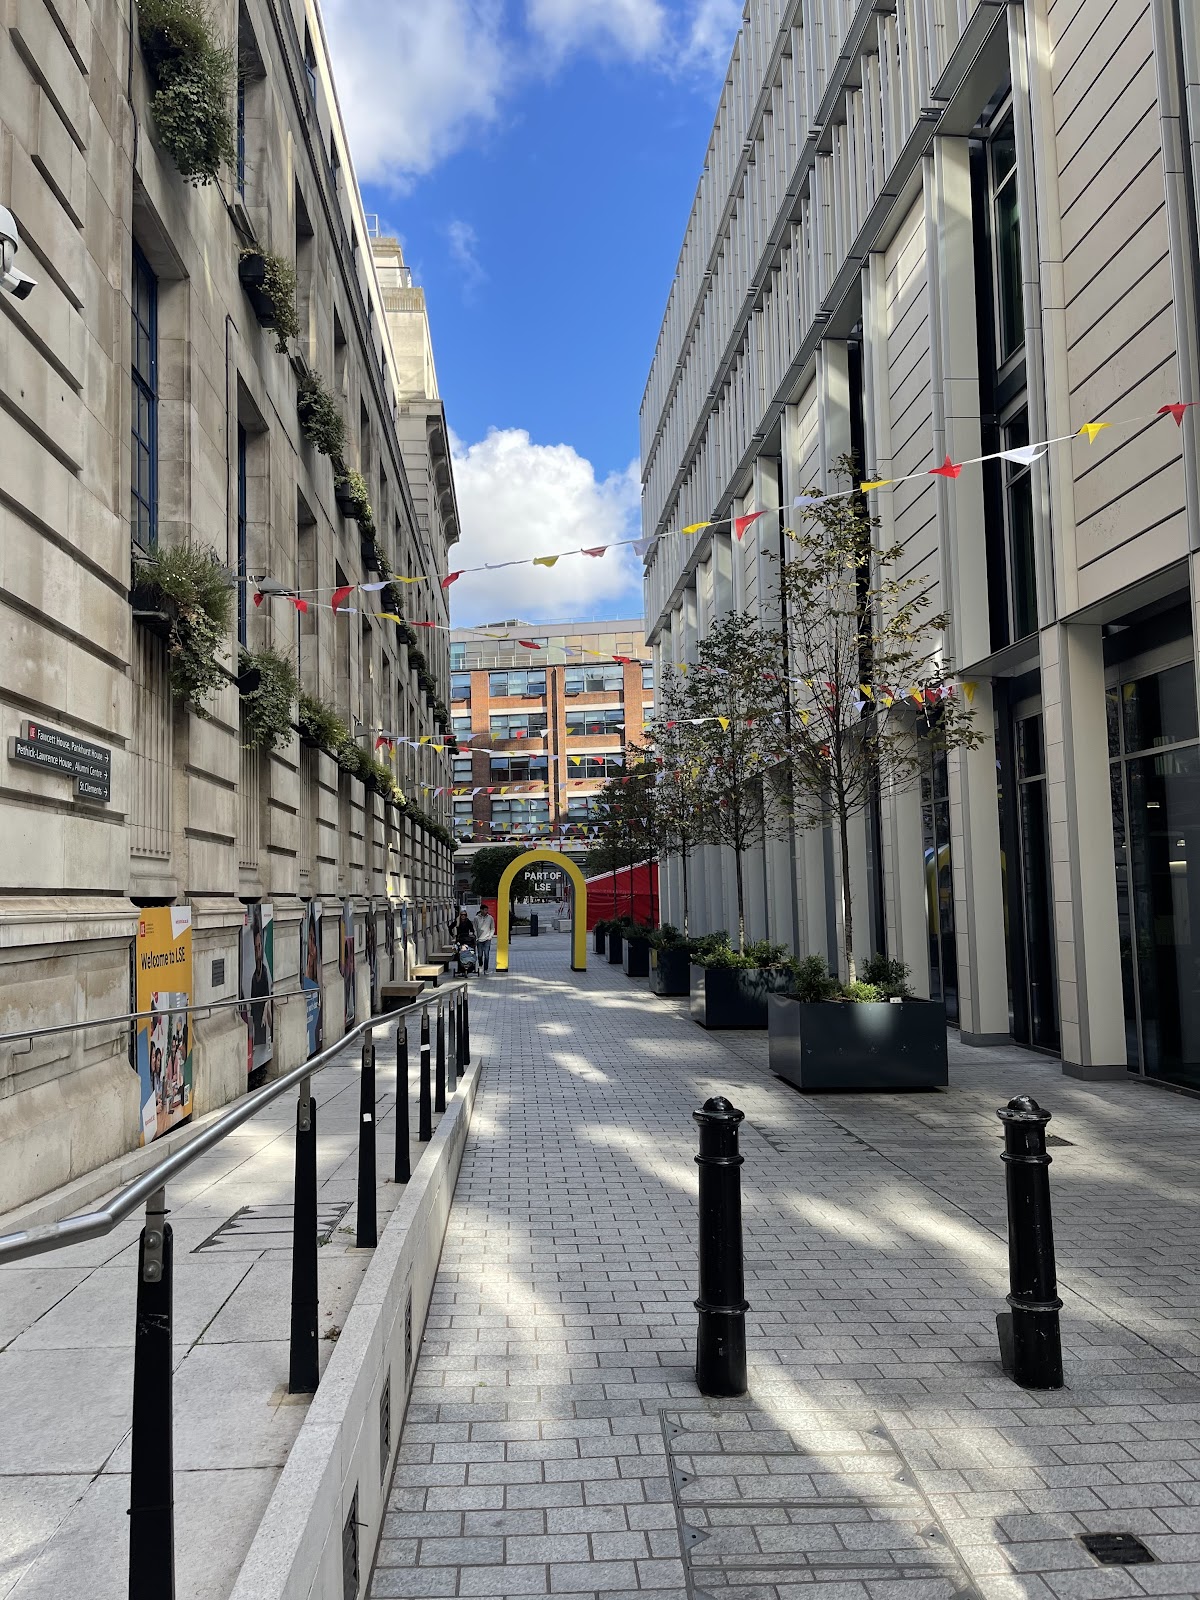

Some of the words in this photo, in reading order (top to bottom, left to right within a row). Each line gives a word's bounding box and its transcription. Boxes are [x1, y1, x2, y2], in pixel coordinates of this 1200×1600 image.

[37, 730, 56, 744] Fawcett
[56, 738, 71, 751] House,
[75, 762, 90, 773] Alumni
[90, 767, 103, 778] Centre
[524, 872, 548, 880] PART
[549, 872, 562, 880] OF
[534, 883, 551, 891] LSE
[141, 951, 169, 970] Welcome
[169, 950, 175, 965] to
[175, 946, 186, 963] LSE
